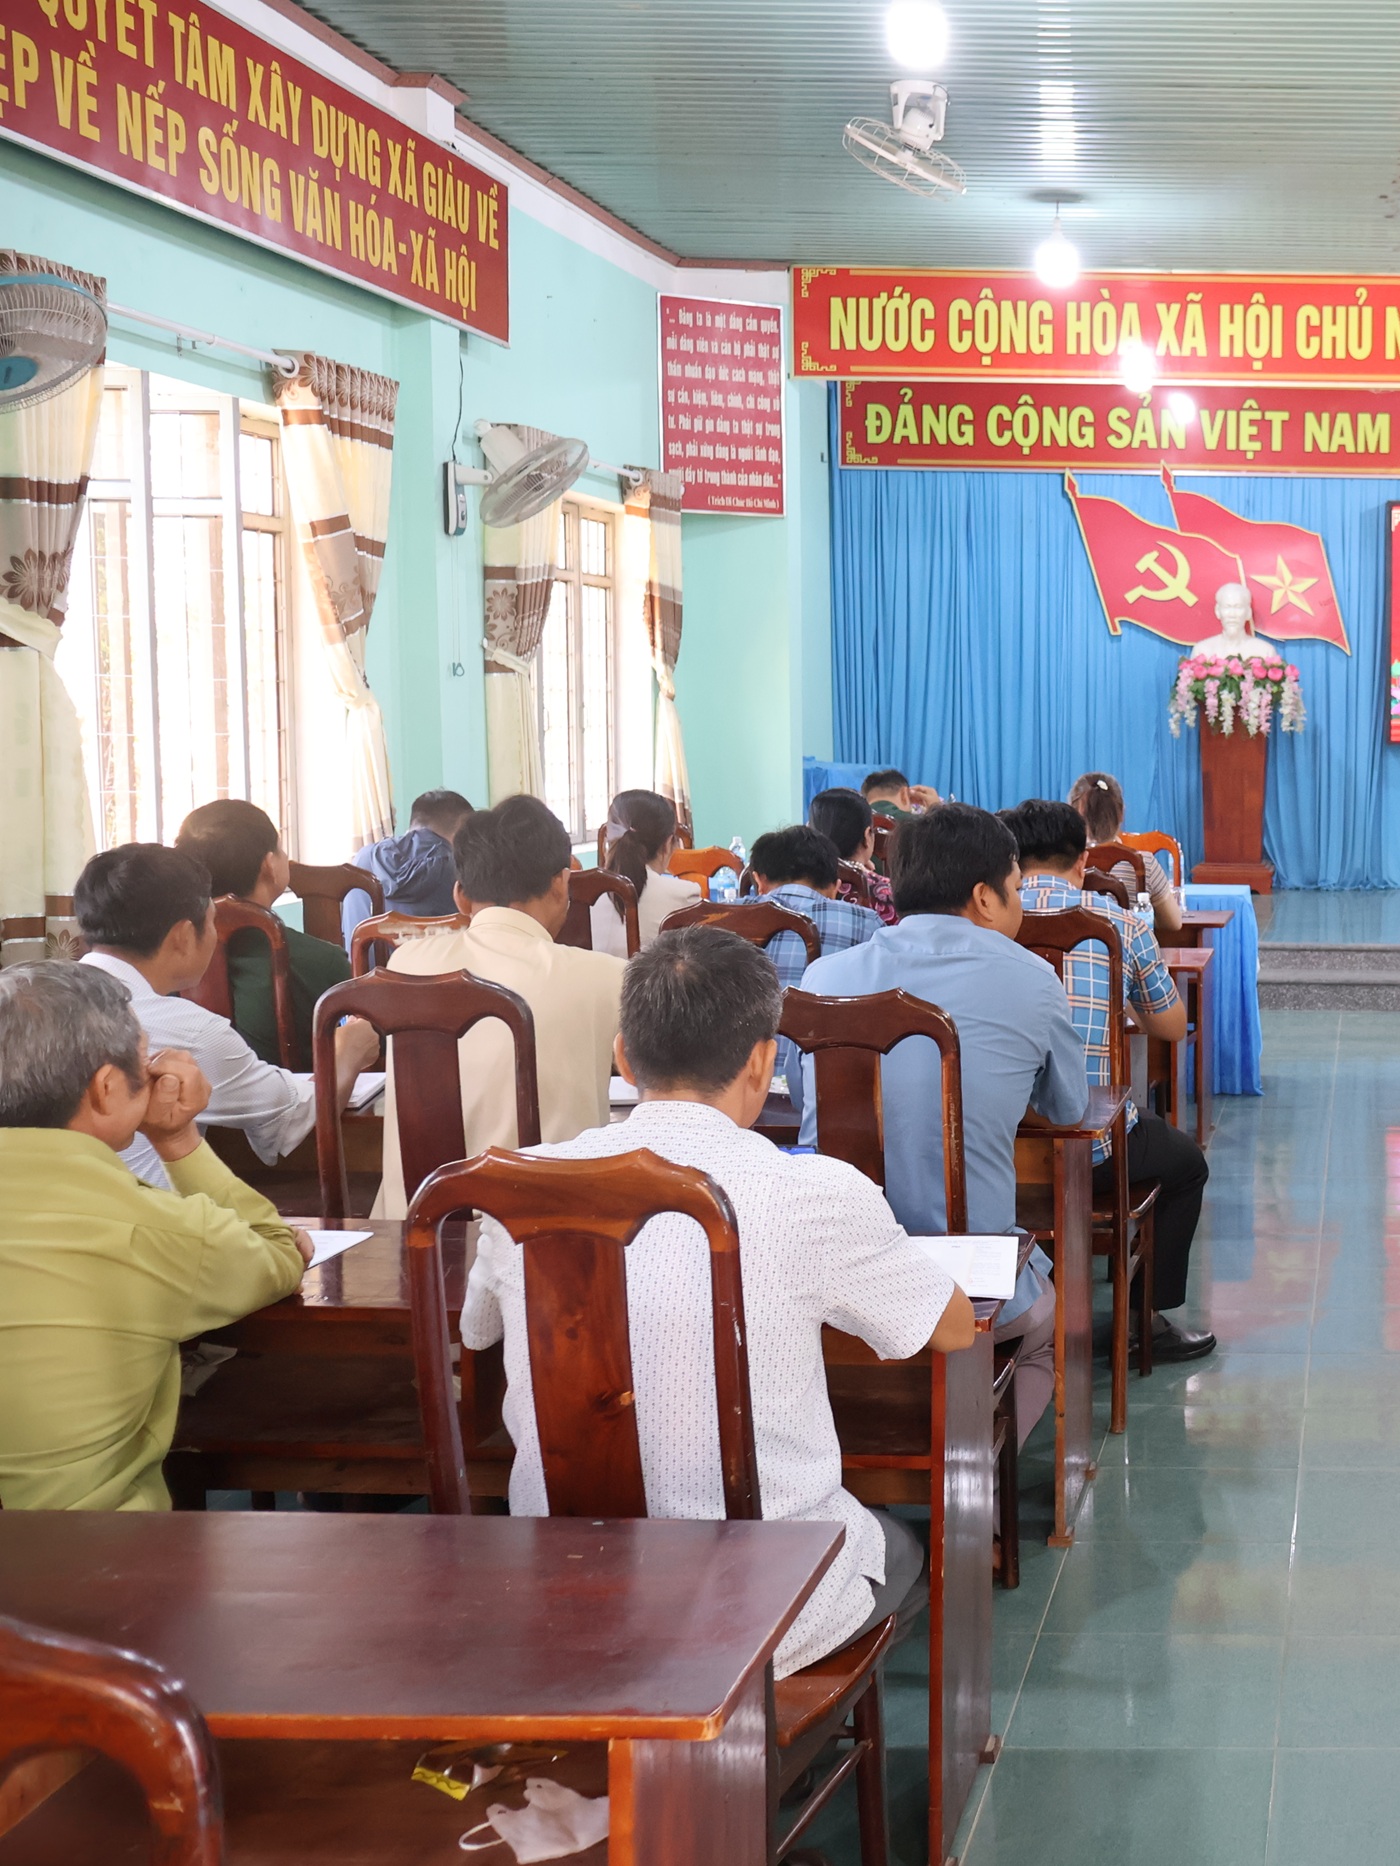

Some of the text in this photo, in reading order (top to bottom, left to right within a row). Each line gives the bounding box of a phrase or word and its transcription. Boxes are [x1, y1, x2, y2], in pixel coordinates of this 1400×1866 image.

[50, 39, 100, 143] VỀ
[116, 80, 186, 177] NẾP
[198, 119, 282, 224] SỐNG
[289, 166, 342, 251] VĂN
[445, 243, 477, 320] HỘI
[168, 12, 237, 112] TÂM
[246, 60, 303, 146] XÂY
[312, 95, 381, 189] DỰNG
[387, 139, 419, 210] XÃ
[422, 159, 470, 235] GIÀU
[476, 181, 500, 251] VỀ
[830, 286, 935, 353] NƯỚC
[948, 287, 1053, 366] CỘNG
[1066, 288, 1145, 356] HÒA
[1155, 292, 1207, 357] XÃ
[1219, 292, 1283, 370] HỘI
[1296, 286, 1373, 360] CHỦ
[865, 387, 974, 446] ĐẢNG
[986, 394, 1095, 455] CỘNG
[1106, 392, 1188, 449] SẢN
[1199, 399, 1290, 460] VIỆT
[1304, 412, 1390, 454] NAM
